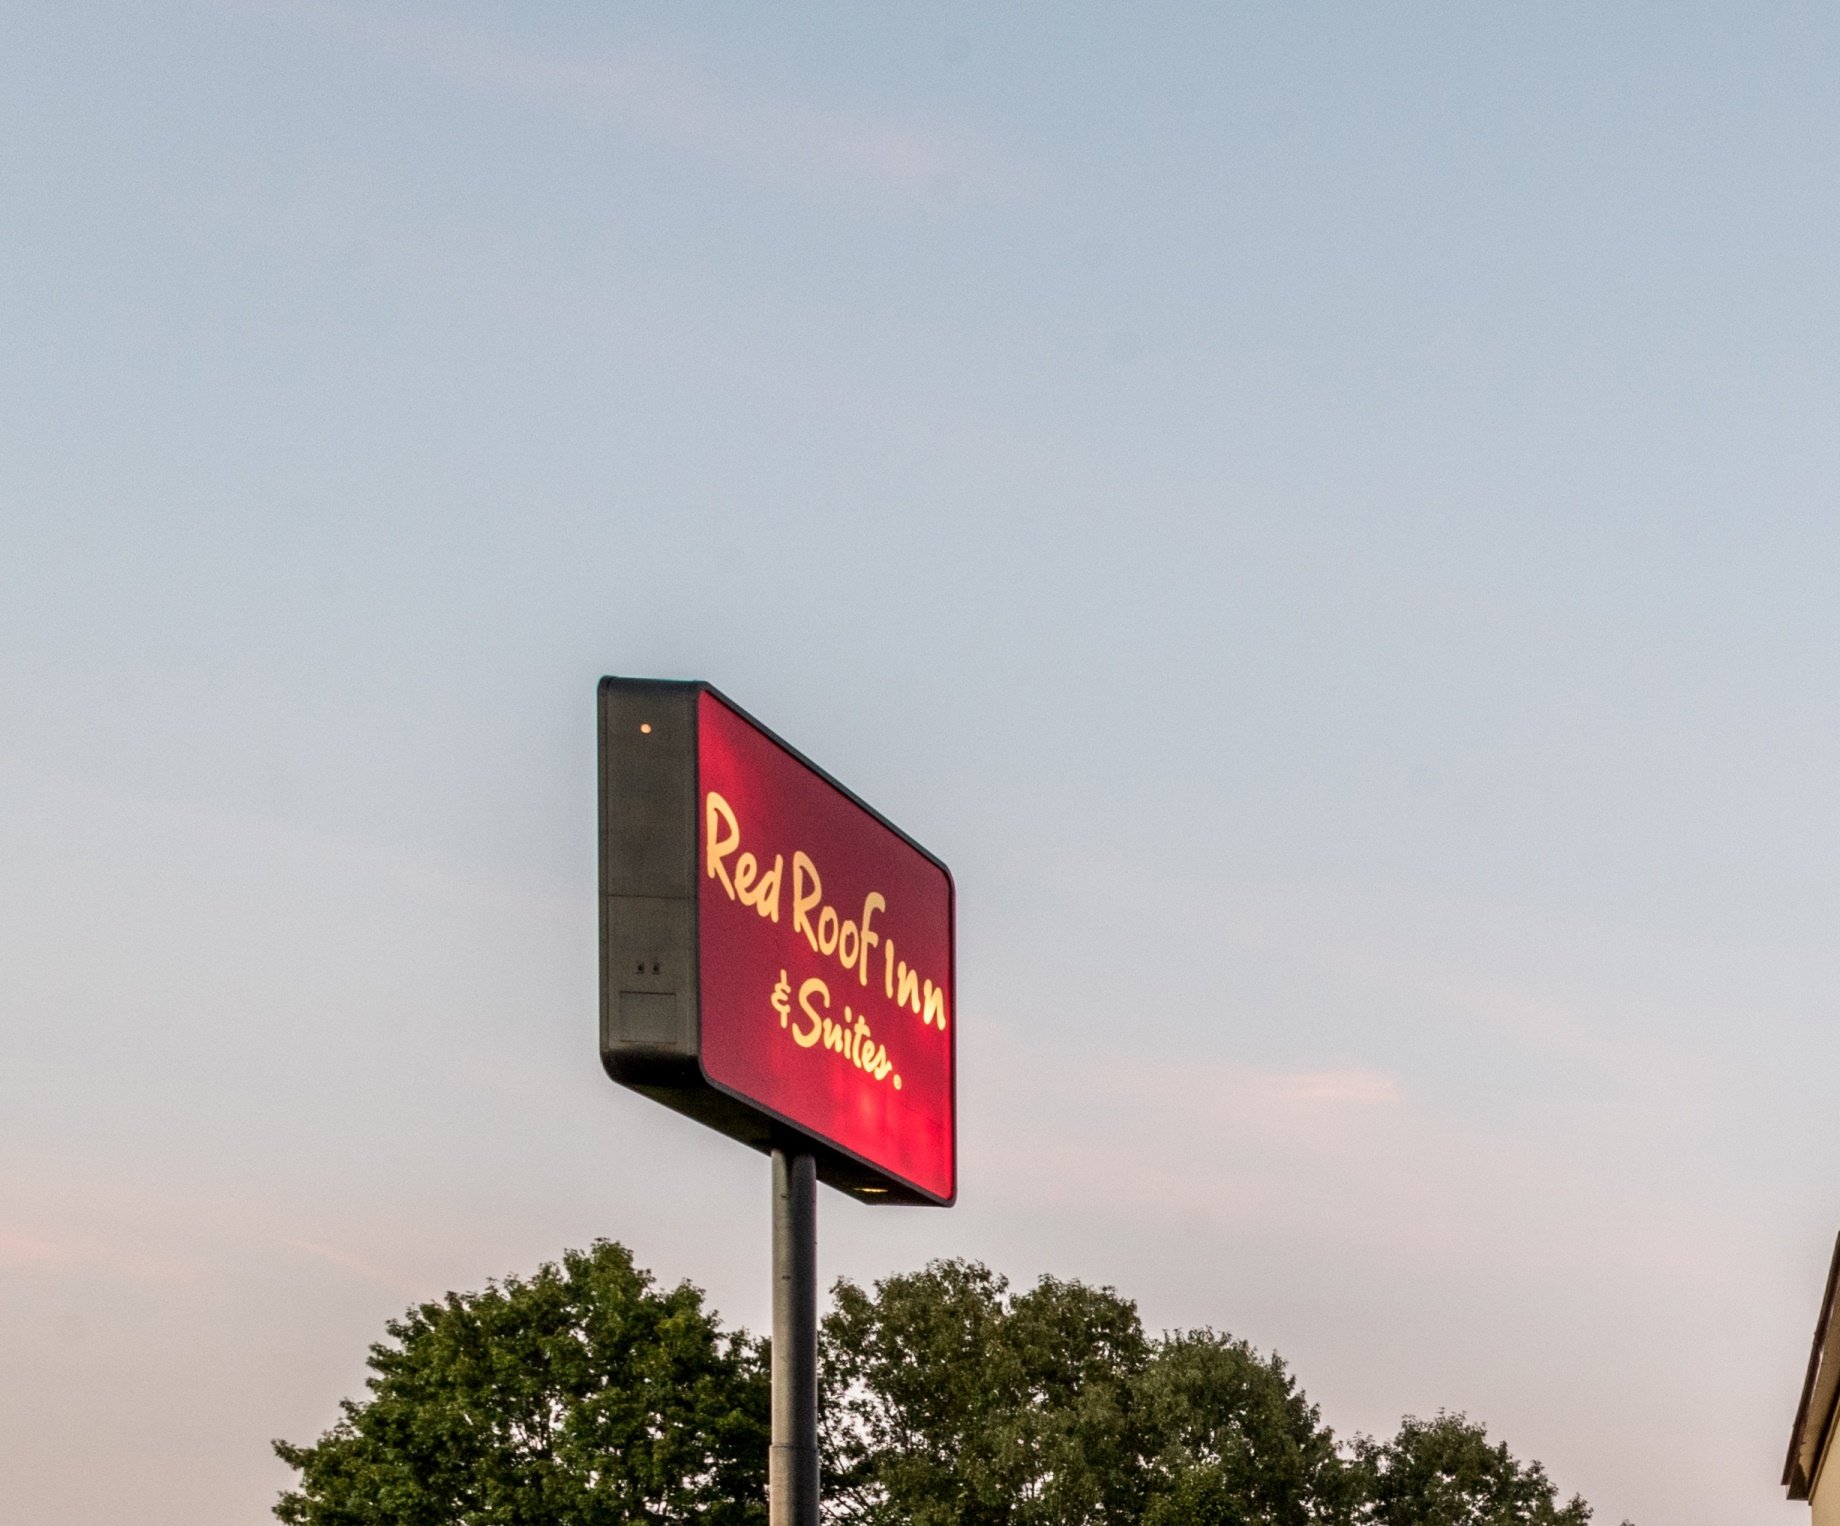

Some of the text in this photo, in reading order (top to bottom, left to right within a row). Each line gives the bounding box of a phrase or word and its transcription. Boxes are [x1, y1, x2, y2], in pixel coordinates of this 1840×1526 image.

[705, 790, 947, 1032] Red Roof Inn
[770, 968, 894, 1082] & Suites
